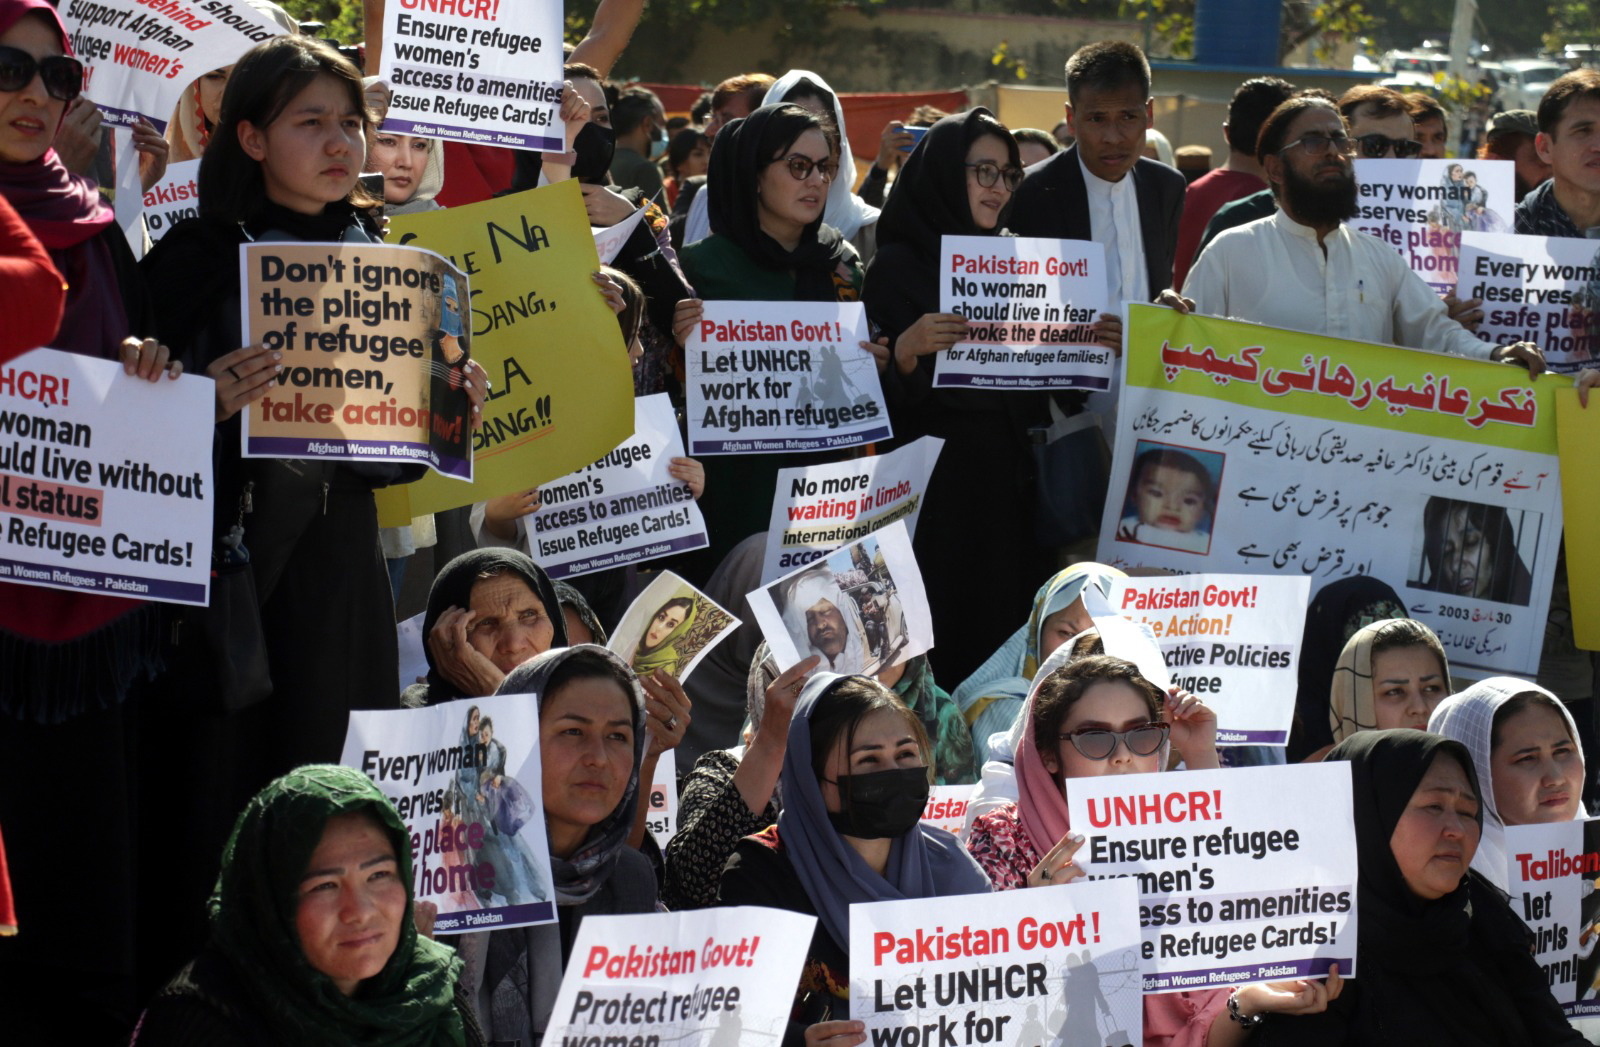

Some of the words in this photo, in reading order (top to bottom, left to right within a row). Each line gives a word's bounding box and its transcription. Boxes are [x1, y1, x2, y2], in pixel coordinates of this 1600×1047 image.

[66, 0, 131, 29] support
[125, 13, 194, 52] Afghan
[201, 0, 276, 42] should
[396, 13, 468, 43] Ensure
[471, 28, 542, 54] refugee
[114, 43, 184, 79] women's
[394, 42, 480, 69] women's
[391, 67, 452, 91] access
[456, 72, 474, 93] to
[477, 79, 563, 104] amenities
[388, 90, 430, 111] Issue
[433, 95, 499, 122] Refugee
[502, 104, 553, 126] Cards!
[412, 124, 436, 135] Afghan
[437, 127, 461, 137] Women
[462, 130, 492, 141] Refugees
[497, 135, 525, 145] Pakistan
[143, 180, 199, 207] akist
[1397, 183, 1472, 200] woman
[261, 255, 346, 284] Don't
[353, 256, 440, 294] ignore
[951, 254, 1039, 275] Pakistan
[1046, 257, 1088, 277] Govt!
[1475, 256, 1538, 283] Every
[1543, 264, 1600, 281] wom
[951, 277, 977, 297] No
[982, 282, 1047, 299] woman
[1473, 282, 1572, 304] deserves
[261, 288, 314, 316] the
[323, 289, 412, 326] plight
[951, 302, 1010, 321] should
[1013, 303, 1040, 321] live
[1044, 303, 1059, 322] in
[1063, 304, 1096, 323] fear
[1490, 306, 1541, 329] safe
[263, 322, 297, 351] of
[305, 323, 424, 362] refugee
[700, 319, 787, 343] Pakistan
[1011, 324, 1036, 342] the
[701, 350, 737, 373] Let
[742, 350, 812, 372] UNHCR
[946, 349, 964, 361] for
[966, 349, 1009, 364] Afghan
[1011, 350, 1055, 366] refugee
[1057, 350, 1109, 365] families!
[1161, 340, 1264, 383] کیمپ
[700, 377, 760, 400] work
[763, 376, 792, 399] for
[261, 393, 334, 423] take
[342, 397, 430, 428] action
[701, 405, 780, 432] Afghan
[786, 400, 879, 429] refugees
[1157, 410, 1193, 434] ضمیر
[1466, 388, 1538, 428] فکر
[1191, 416, 1206, 436] کا
[1200, 416, 1252, 446] حکمرانوں
[307, 442, 345, 454] Afghan
[347, 444, 387, 456] Women
[389, 445, 428, 459] Refugees
[722, 442, 752, 452] Afghan
[754, 440, 784, 450] Women
[785, 439, 820, 450] Refugees
[826, 434, 863, 446] Pakistan
[1276, 427, 1306, 460] رہائی
[1306, 429, 1334, 462] کی
[1320, 435, 1363, 464] صدیقی
[42, 447, 92, 484] live
[98, 460, 204, 500] without
[1365, 449, 1395, 472] عافیہ
[1394, 446, 1433, 475] ڈاکٹر
[1432, 452, 1458, 482] بیٹی
[1458, 452, 1488, 486] کی
[791, 478, 817, 497] No
[822, 474, 869, 495] more
[1476, 463, 1504, 491] قوم
[16, 482, 100, 520] status
[535, 505, 587, 533] access
[589, 501, 607, 521] to
[611, 484, 693, 516] amenities
[787, 498, 857, 521] waiting
[861, 494, 872, 513] in
[876, 480, 911, 507] limbo,
[1237, 486, 1269, 507] ہے
[1272, 484, 1301, 512] بھی
[1298, 489, 1340, 520] فرض
[7, 517, 106, 558] Refugee
[112, 533, 193, 567] Cards!
[538, 538, 576, 557] Issue
[577, 524, 639, 548] Refugee
[642, 507, 691, 533] Cards!
[783, 521, 871, 545] international
[569, 562, 590, 573] Afghan
[590, 558, 614, 569] Women
[614, 551, 641, 563] Refugees
[645, 544, 671, 555] Pakistan
[1237, 543, 1270, 565] ہے
[1273, 541, 1302, 569] بھی
[13, 565, 50, 580] Women
[53, 571, 96, 587] Refugees
[105, 578, 148, 593] Pakistan
[1121, 587, 1200, 610] Pakistan
[1202, 585, 1257, 608] Govt!
[1165, 614, 1232, 638] Action!
[1439, 605, 1469, 620] 2003
[1496, 612, 1512, 625] 30
[1209, 644, 1291, 668] Policies
[1215, 732, 1248, 742] Pakistan
[362, 750, 426, 786] Every
[426, 743, 487, 775] woman
[1086, 789, 1222, 828] UNHCR!
[422, 818, 484, 866] place
[1089, 835, 1187, 864] Ensure
[1193, 826, 1300, 860] refugee
[420, 861, 495, 898] home
[466, 913, 503, 925] Pakistan
[1187, 897, 1213, 924] to
[1219, 886, 1350, 922] amenities
[1523, 891, 1552, 921] let
[873, 925, 1009, 966] Pakistan
[1160, 932, 1256, 959] Refugee
[1261, 921, 1337, 950] Cards!
[582, 945, 695, 979] Pakistan
[700, 936, 761, 971] Govt!
[874, 977, 926, 1013] Let
[934, 963, 1048, 1007] UNHCR
[1142, 977, 1169, 989] fghan
[1172, 973, 1207, 986] Women
[1209, 970, 1250, 983] Refugees
[1258, 965, 1297, 978] Pakistan
[568, 987, 667, 1025] Protect
[670, 983, 740, 1022] refugee
[871, 1014, 958, 1047] work
[964, 1011, 1011, 1044] for
